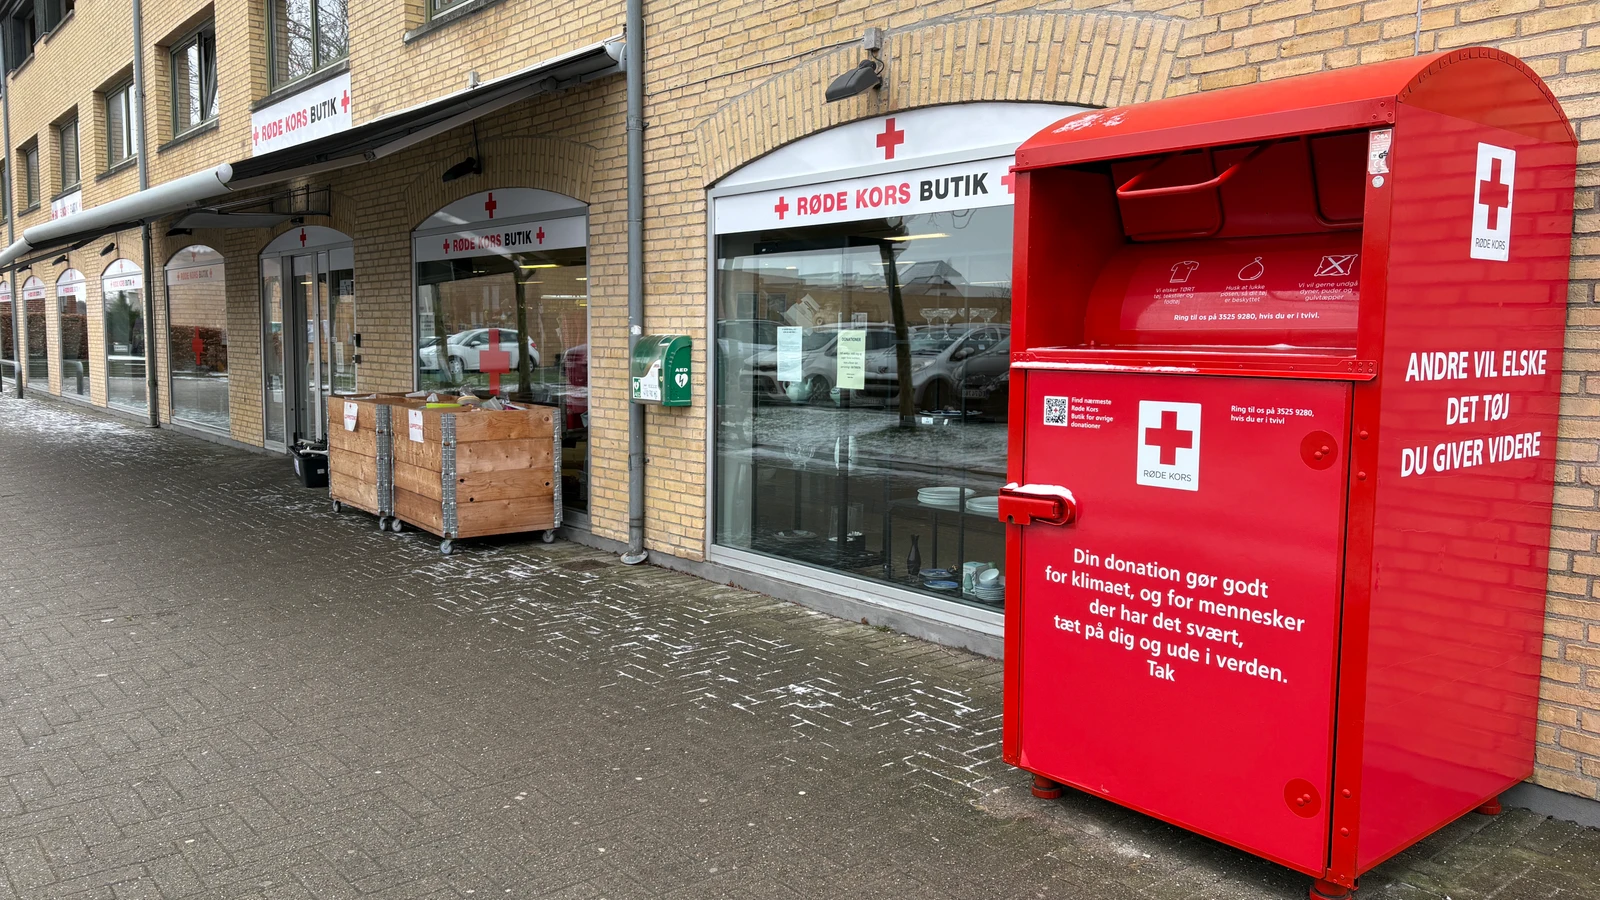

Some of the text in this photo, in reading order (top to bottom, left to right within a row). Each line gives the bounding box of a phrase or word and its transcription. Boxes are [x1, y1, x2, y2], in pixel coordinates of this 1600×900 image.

[261, 97, 337, 141] RØDE KORS BUTIK
[796, 172, 988, 215] RØDE KORS BUTIK
[453, 230, 532, 252] RØDE KORS BUTIK
[1475, 238, 1505, 250] RØDE KORS
[1208, 313, 1217, 321] på
[1405, 350, 1547, 382] ANDRE VIL ELSKE
[1096, 415, 1113, 423] øvrige
[1231, 405, 1246, 414] Ring
[1266, 407, 1275, 415] på
[1295, 408, 1314, 417] 9280,
[1446, 393, 1510, 425] DET TØJ
[1401, 432, 1541, 477] DU GIVER VIDERE
[1144, 470, 1191, 482] RØDE KORS
[1074, 548, 1268, 598] Din donation gør godt
[1045, 566, 1305, 632] for klimaet, og for mennesker
[1089, 598, 1244, 648] der har det svært,
[1054, 614, 1288, 683] tæt på dig og ude i verden.
[1147, 659, 1175, 682] Tak
